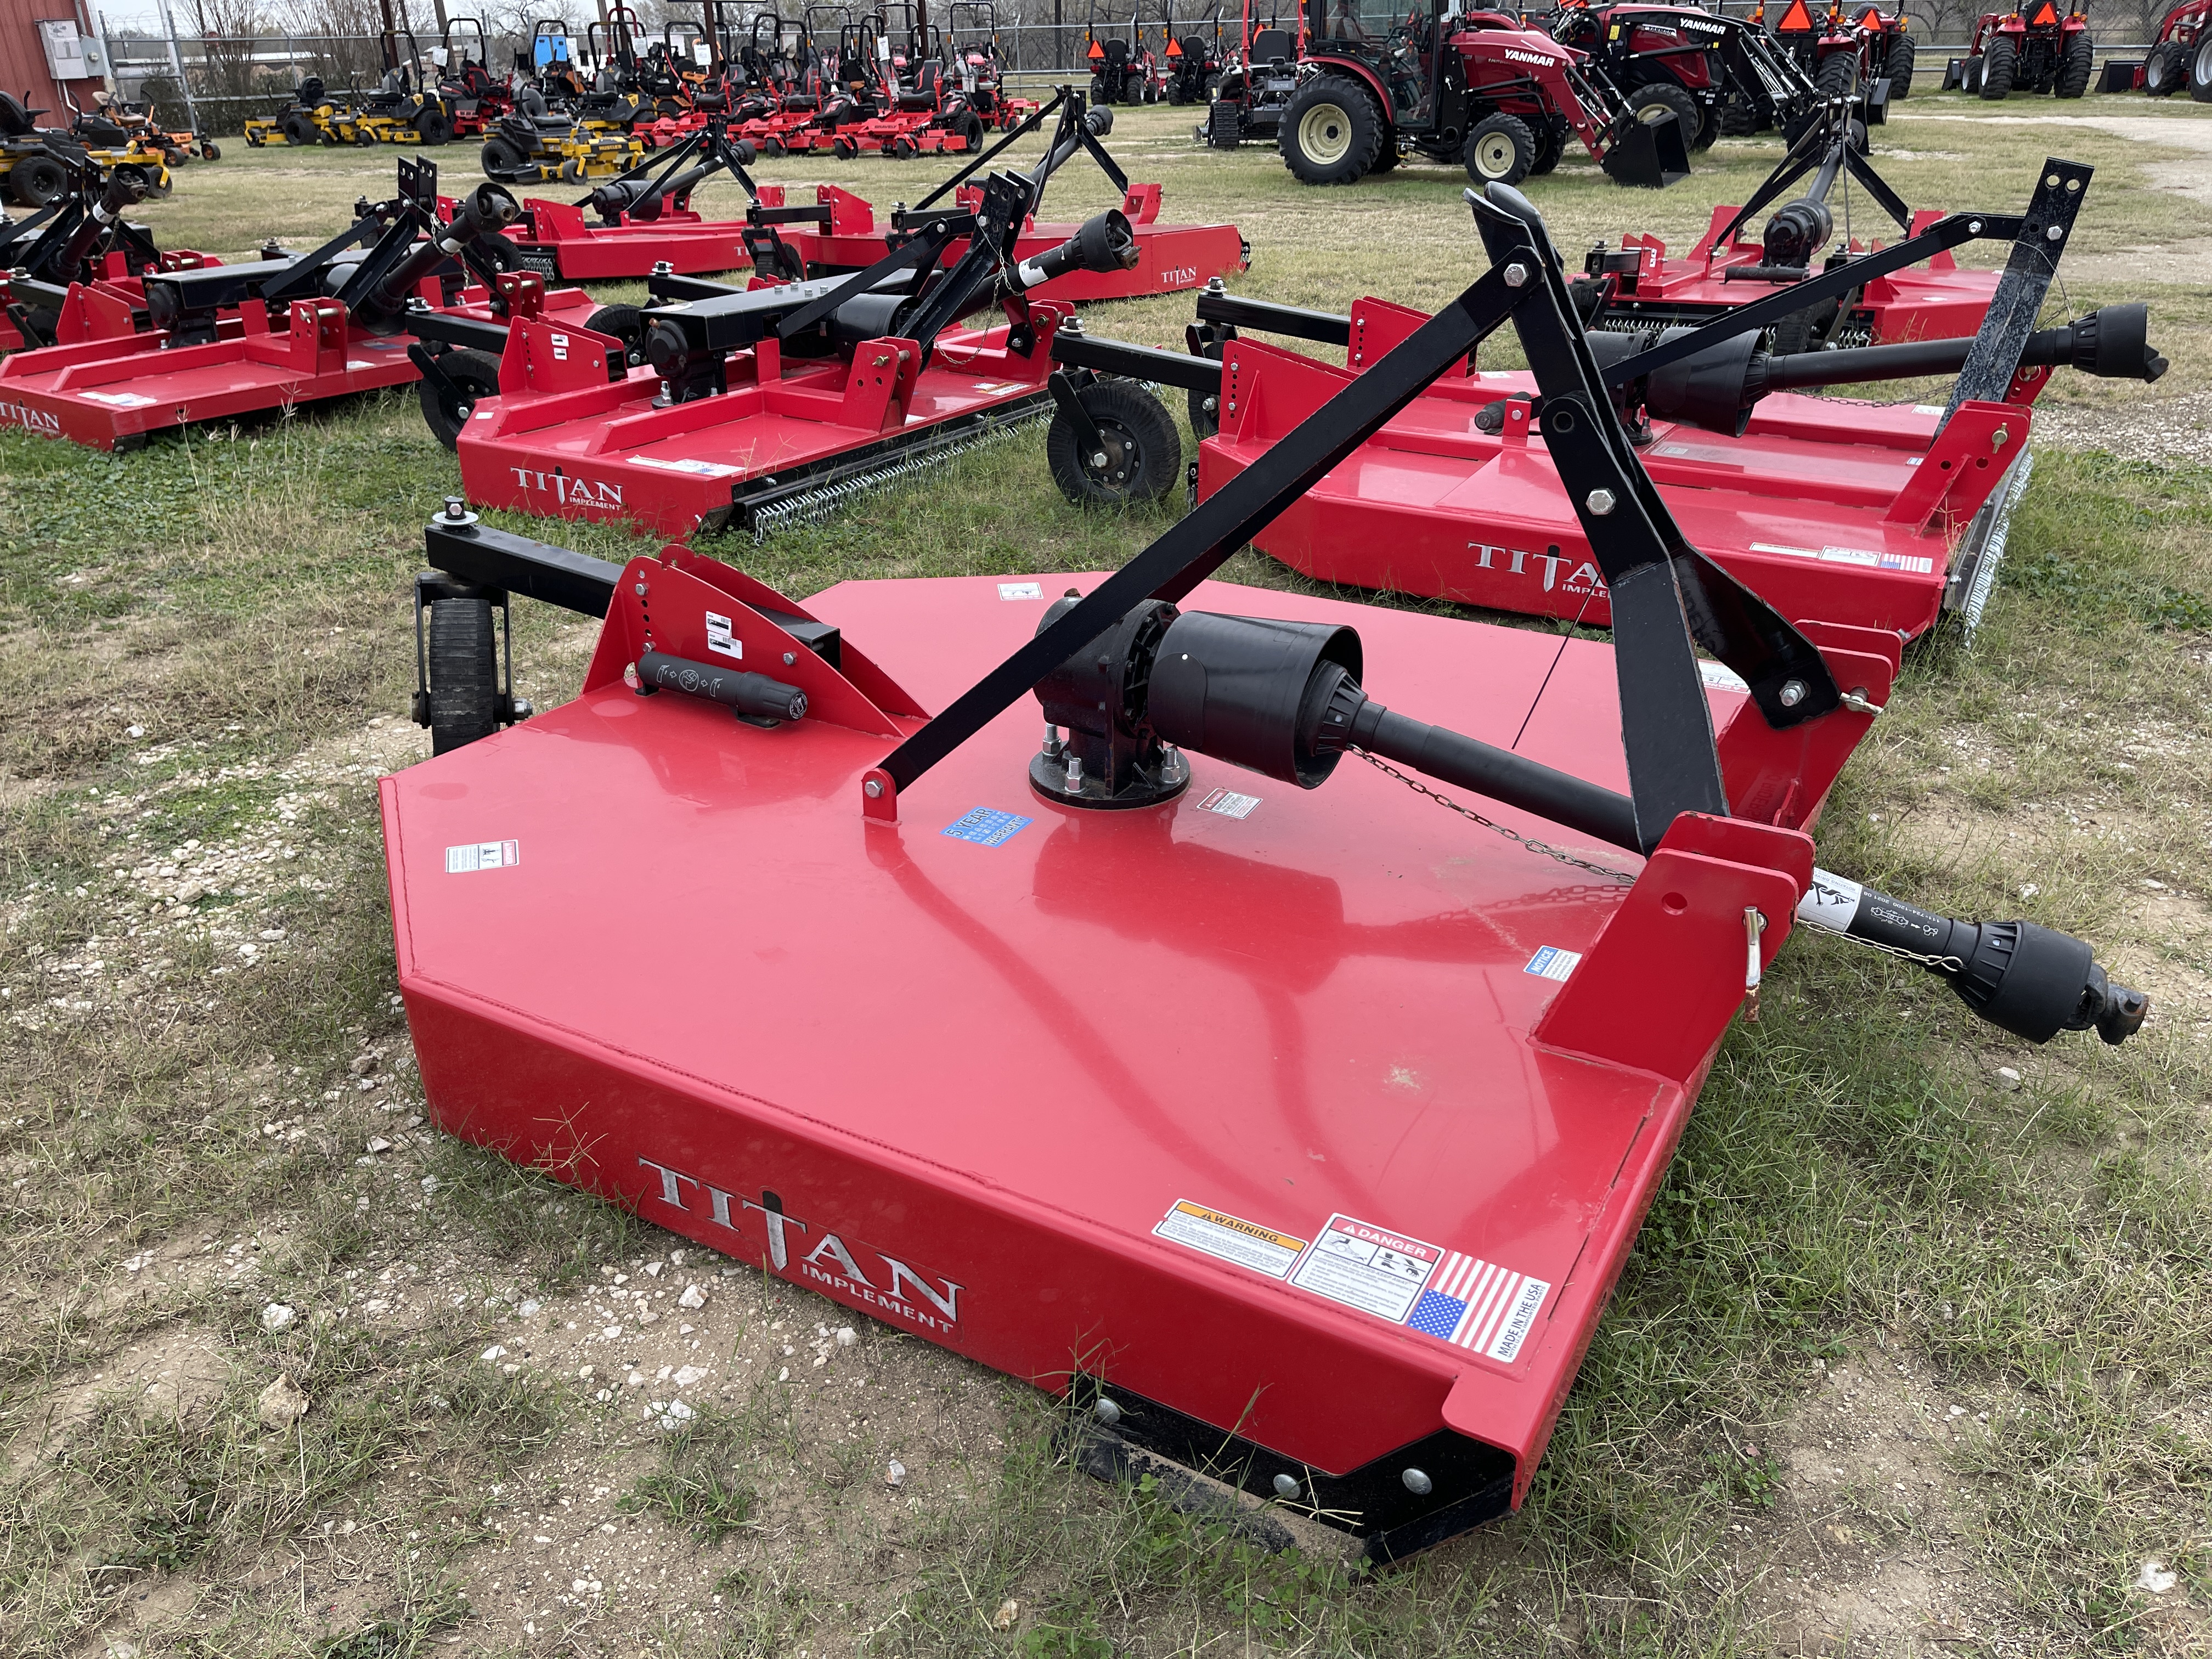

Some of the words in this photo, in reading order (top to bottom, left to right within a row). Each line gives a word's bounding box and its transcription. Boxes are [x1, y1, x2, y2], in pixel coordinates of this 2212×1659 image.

[1680, 18, 1726, 35] YANMAR
[1505, 49, 1555, 67] YANMAR
[1161, 266, 1197, 286] TITAN
[510, 466, 623, 505] TITAN
[569, 496, 621, 511] IMPLEMENT
[1468, 542, 1608, 592] TITA
[1562, 584, 1610, 599] IMPLE
[955, 809, 995, 829] YEAR
[983, 815, 1028, 845] WARRANTY
[1874, 895, 1890, 904] 2021
[1531, 949, 1554, 972] NOTICE
[638, 1156, 966, 1322] TITAN
[1214, 1215, 1279, 1242] WARNING
[1358, 1228, 1426, 1257] DANGER
[803, 1263, 953, 1333] IMPLEMENT
[1525, 1284, 1542, 1301] USA
[1516, 1301, 1533, 1317] THE
[1508, 1344, 1518, 1358] WITH
[1523, 1302, 1538, 1329] IMPORTED
[1535, 1286, 1546, 1302] PARTS
[1511, 1318, 1524, 1329] IN
[1498, 1329, 1519, 1356] MADE
